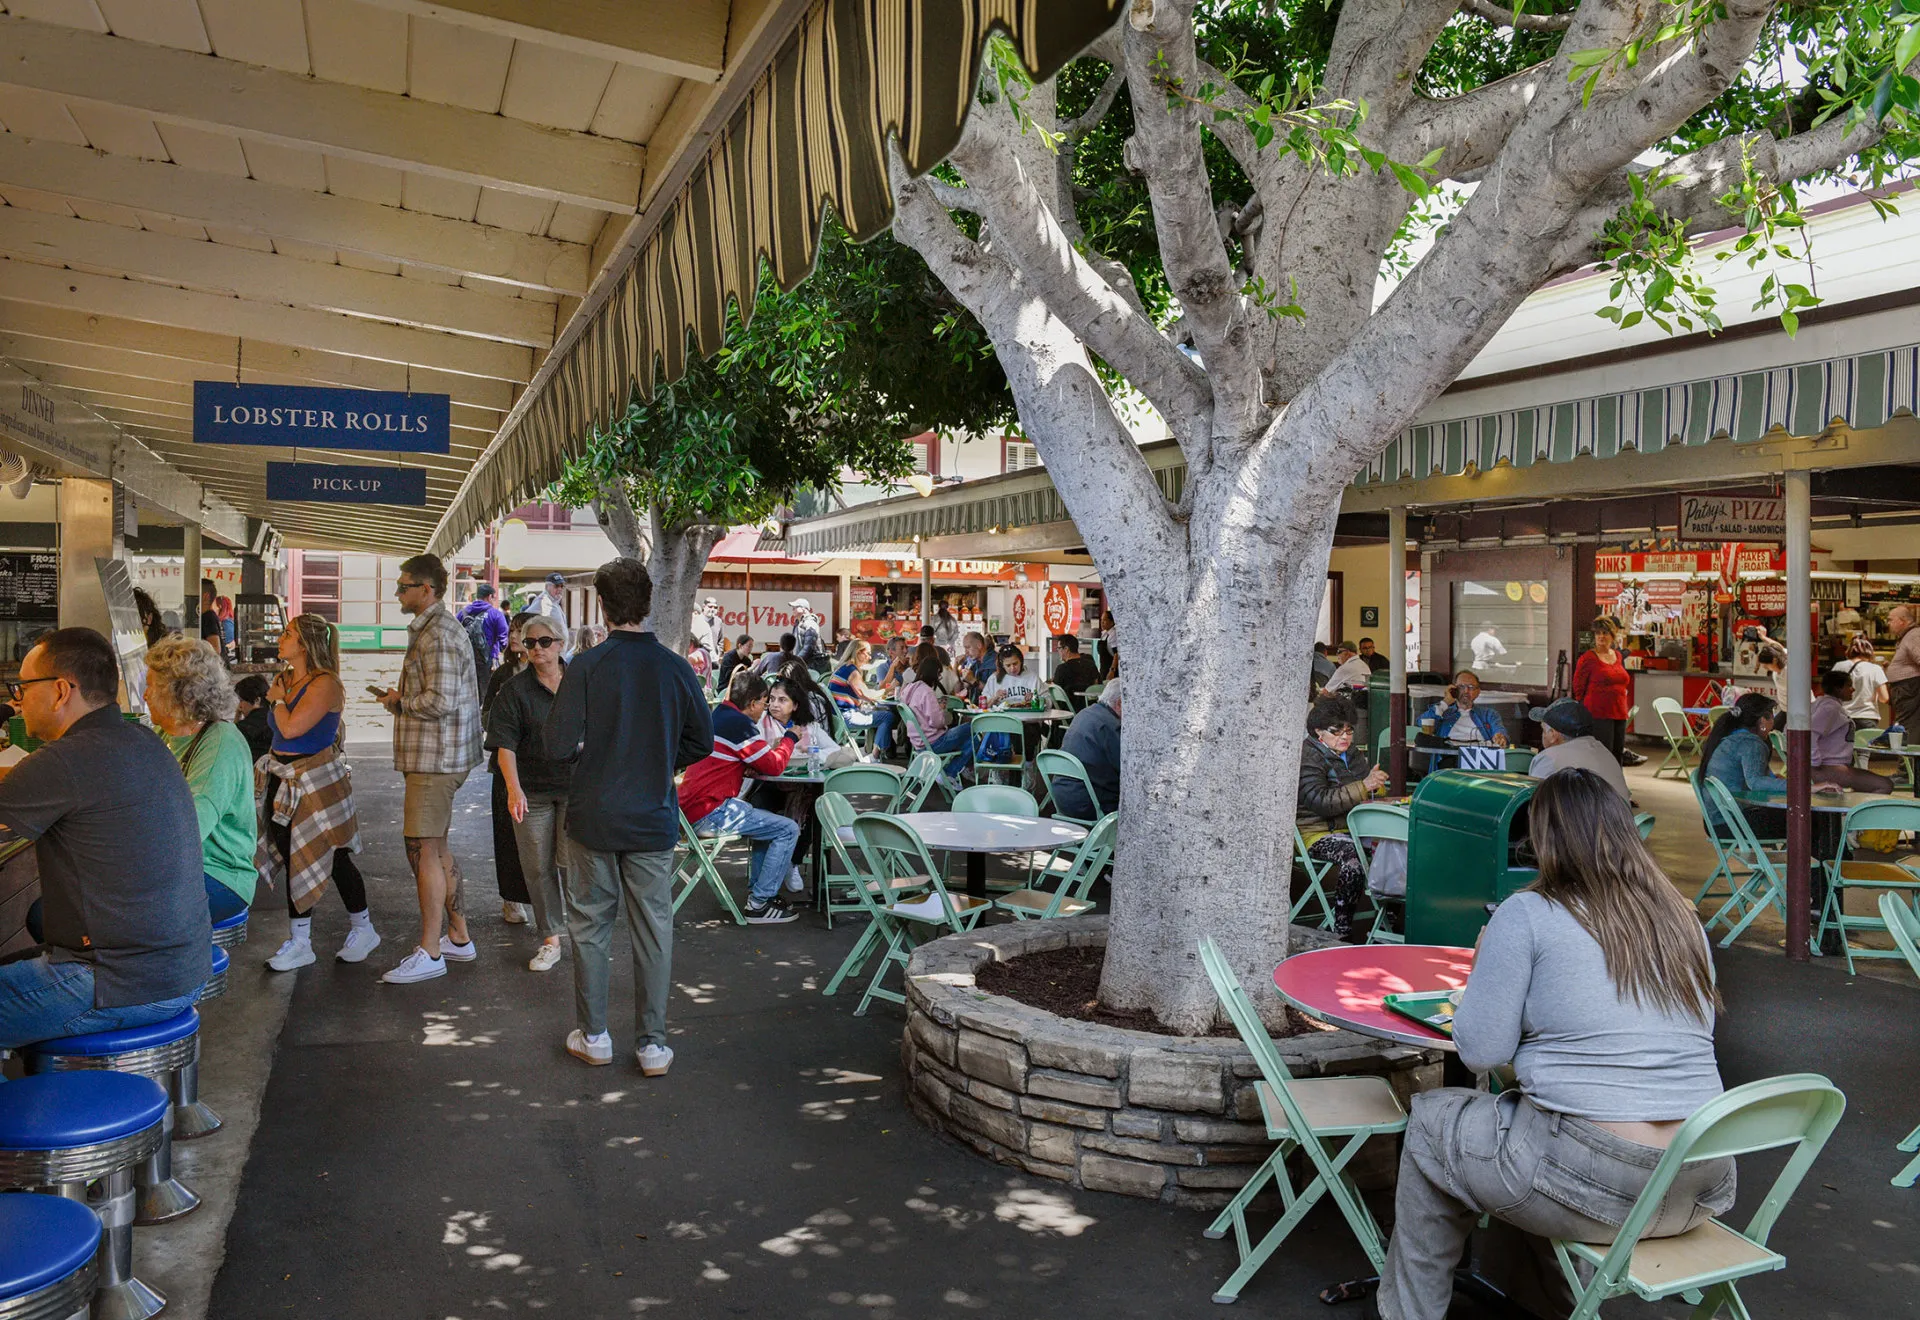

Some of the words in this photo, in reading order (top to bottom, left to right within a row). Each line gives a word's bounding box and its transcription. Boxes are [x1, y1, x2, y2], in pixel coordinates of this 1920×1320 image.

[21, 385, 55, 425] DINNER
[213, 405, 337, 429] LOBSTER
[344, 411, 429, 433] ROLLS
[312, 477, 382, 492] PICK-UP
[1684, 498, 1728, 527] Patsy's
[1692, 523, 1713, 532] PASTA
[1720, 523, 1741, 533] SALAD
[903, 560, 957, 573] FRTZI
[1595, 557, 1627, 572] RINKS
[751, 606, 826, 627] Vino
[1005, 686, 1032, 698] ALIB
